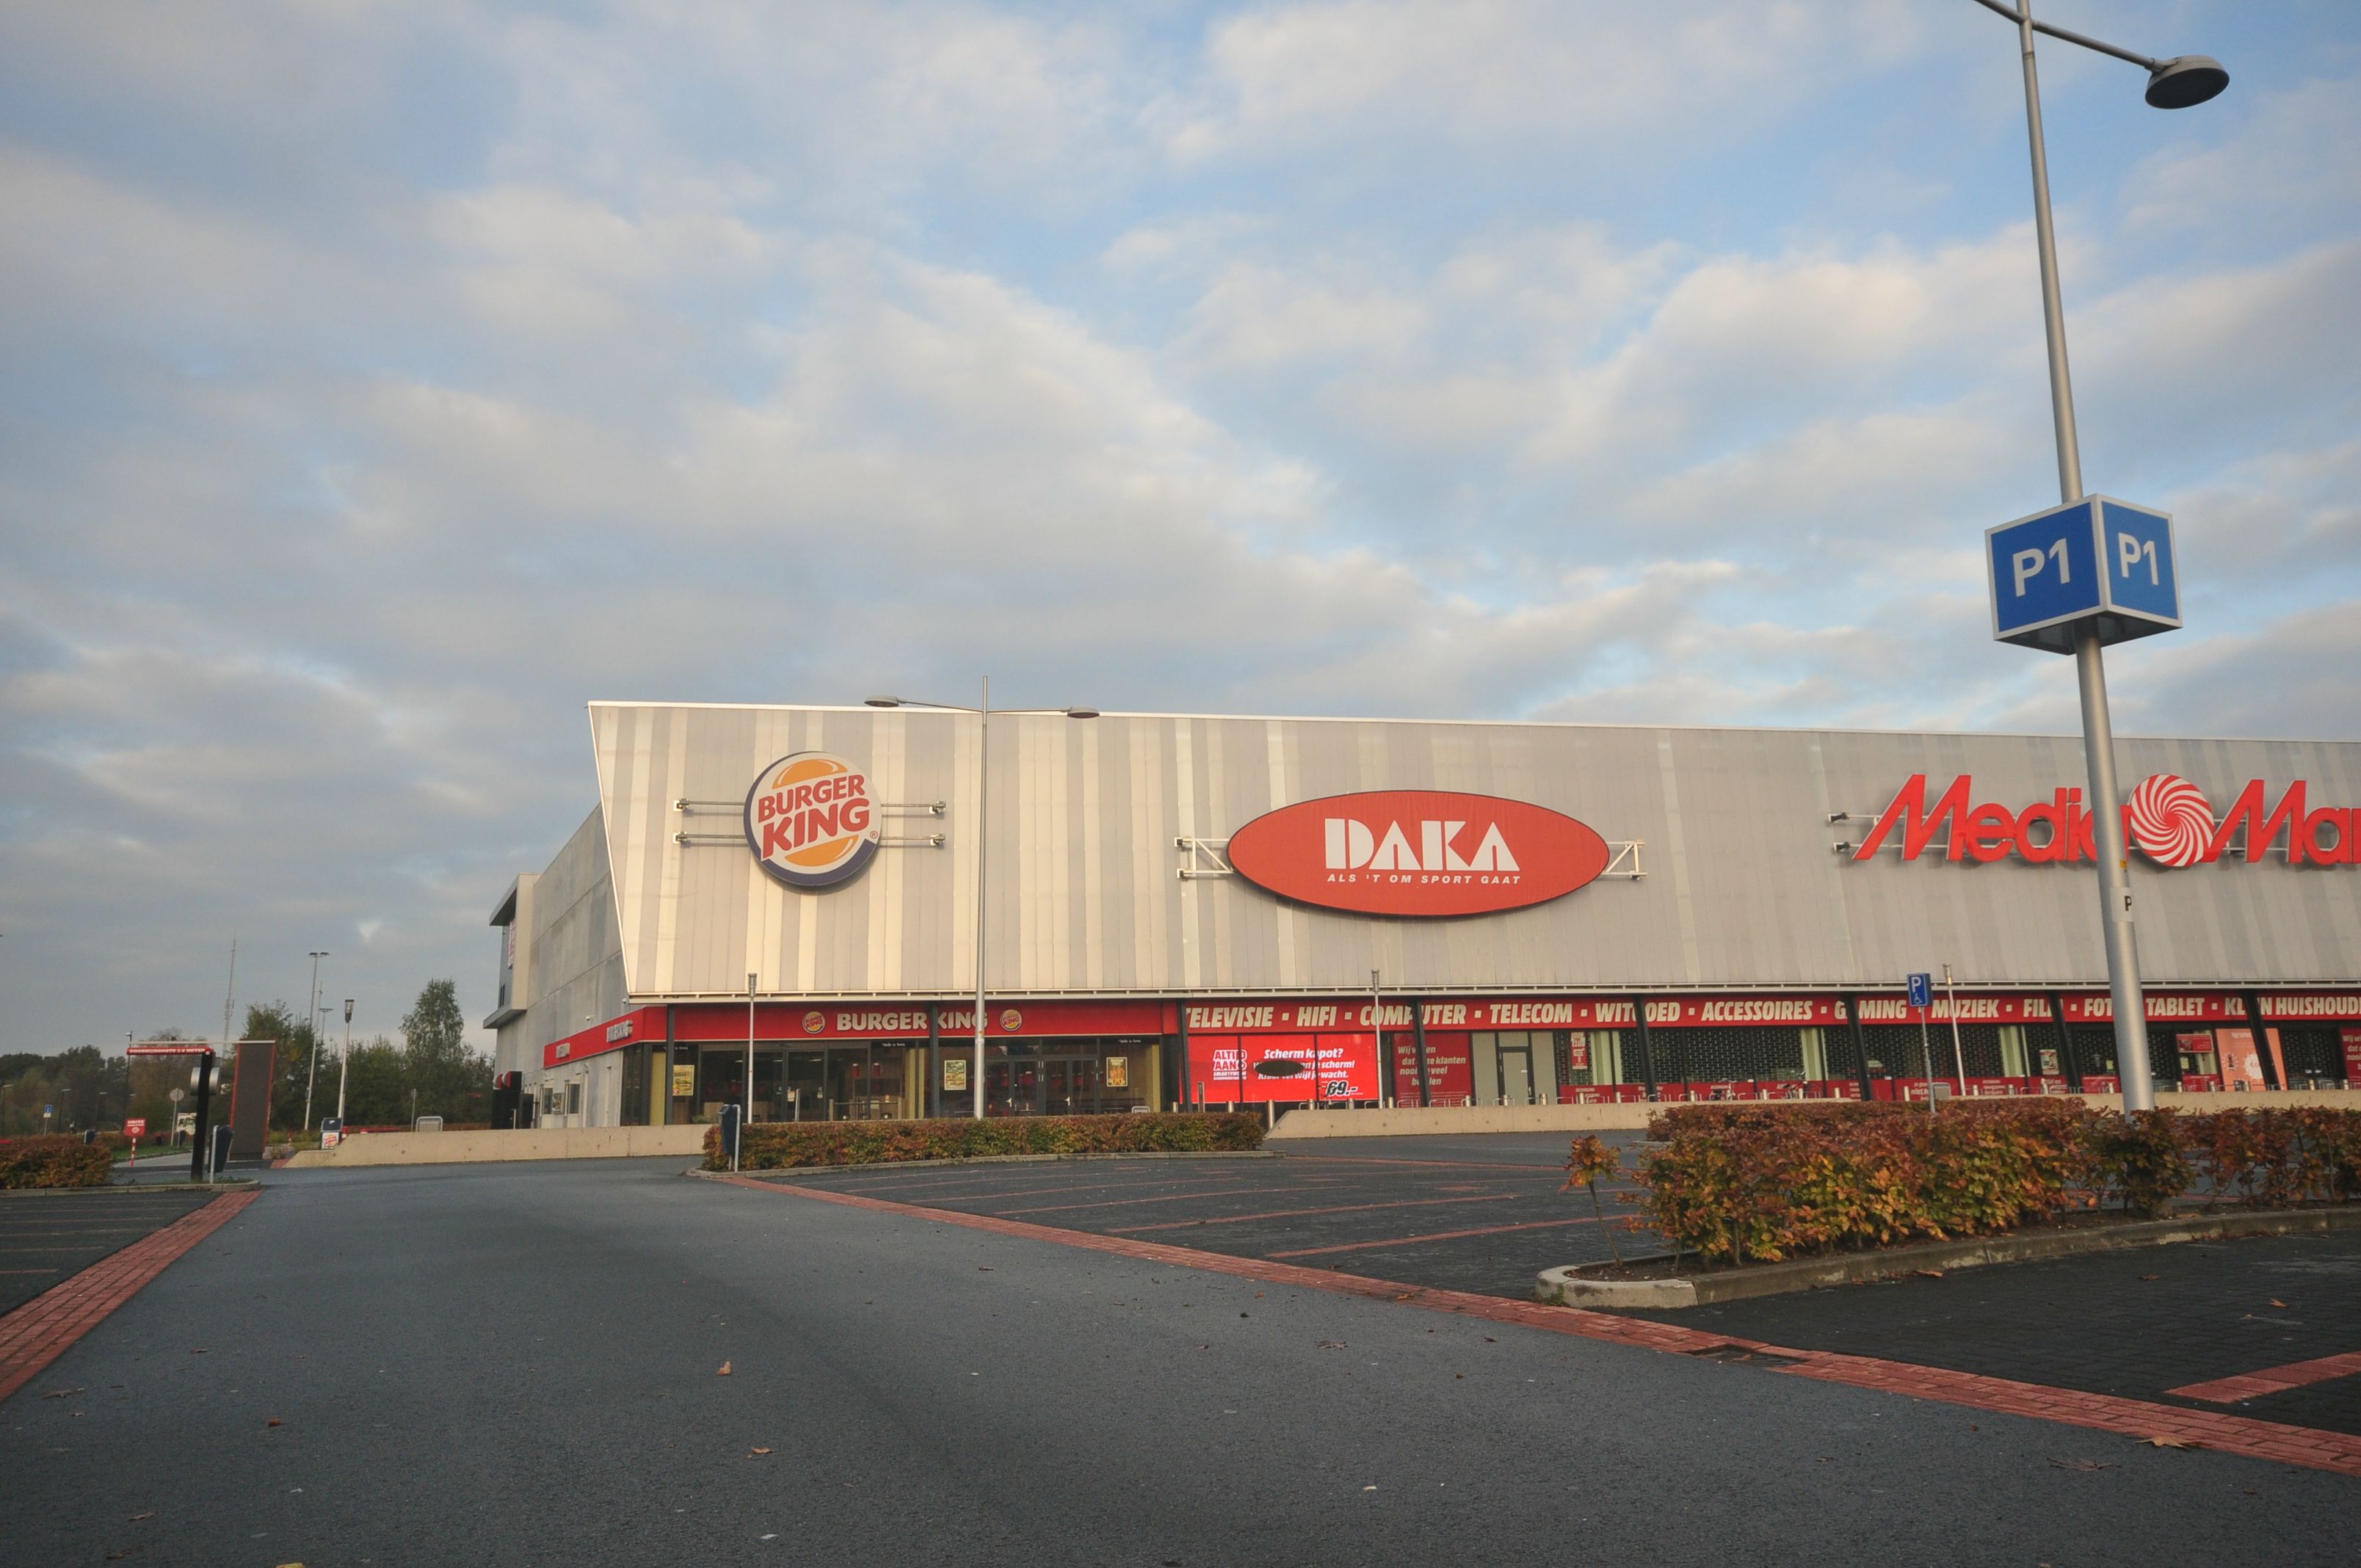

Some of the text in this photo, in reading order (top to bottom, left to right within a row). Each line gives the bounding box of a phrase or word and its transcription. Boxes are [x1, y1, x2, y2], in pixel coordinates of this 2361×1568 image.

[2118, 532, 2158, 585] P1
[2013, 538, 2070, 597] P1
[758, 774, 865, 823] BURGER
[763, 798, 869, 859] KING
[1324, 818, 1520, 871] DAKA
[1327, 874, 1520, 885] ALS 'T OM SPORT GAAT
[1911, 976, 1921, 992] P
[1296, 1006, 1337, 1027] HIFI
[1490, 1003, 1573, 1024] TELECOM
[1701, 1000, 1813, 1021] ACCESSOIRES
[1835, 1000, 1907, 1020] GMING
[1931, 999, 2000, 1018] MUZIEK
[2146, 998, 2205, 1016] TABLET
[837, 1012, 928, 1031] BURGER
[1263, 1049, 1304, 1059] Scherm
[1398, 1045, 1411, 1056] Wij
[1321, 1061, 1355, 1069] scherm!
[1402, 1058, 1415, 1066] dat
[1435, 1056, 1466, 1065] klanten
[1400, 1066, 1448, 1075] nooi veel
